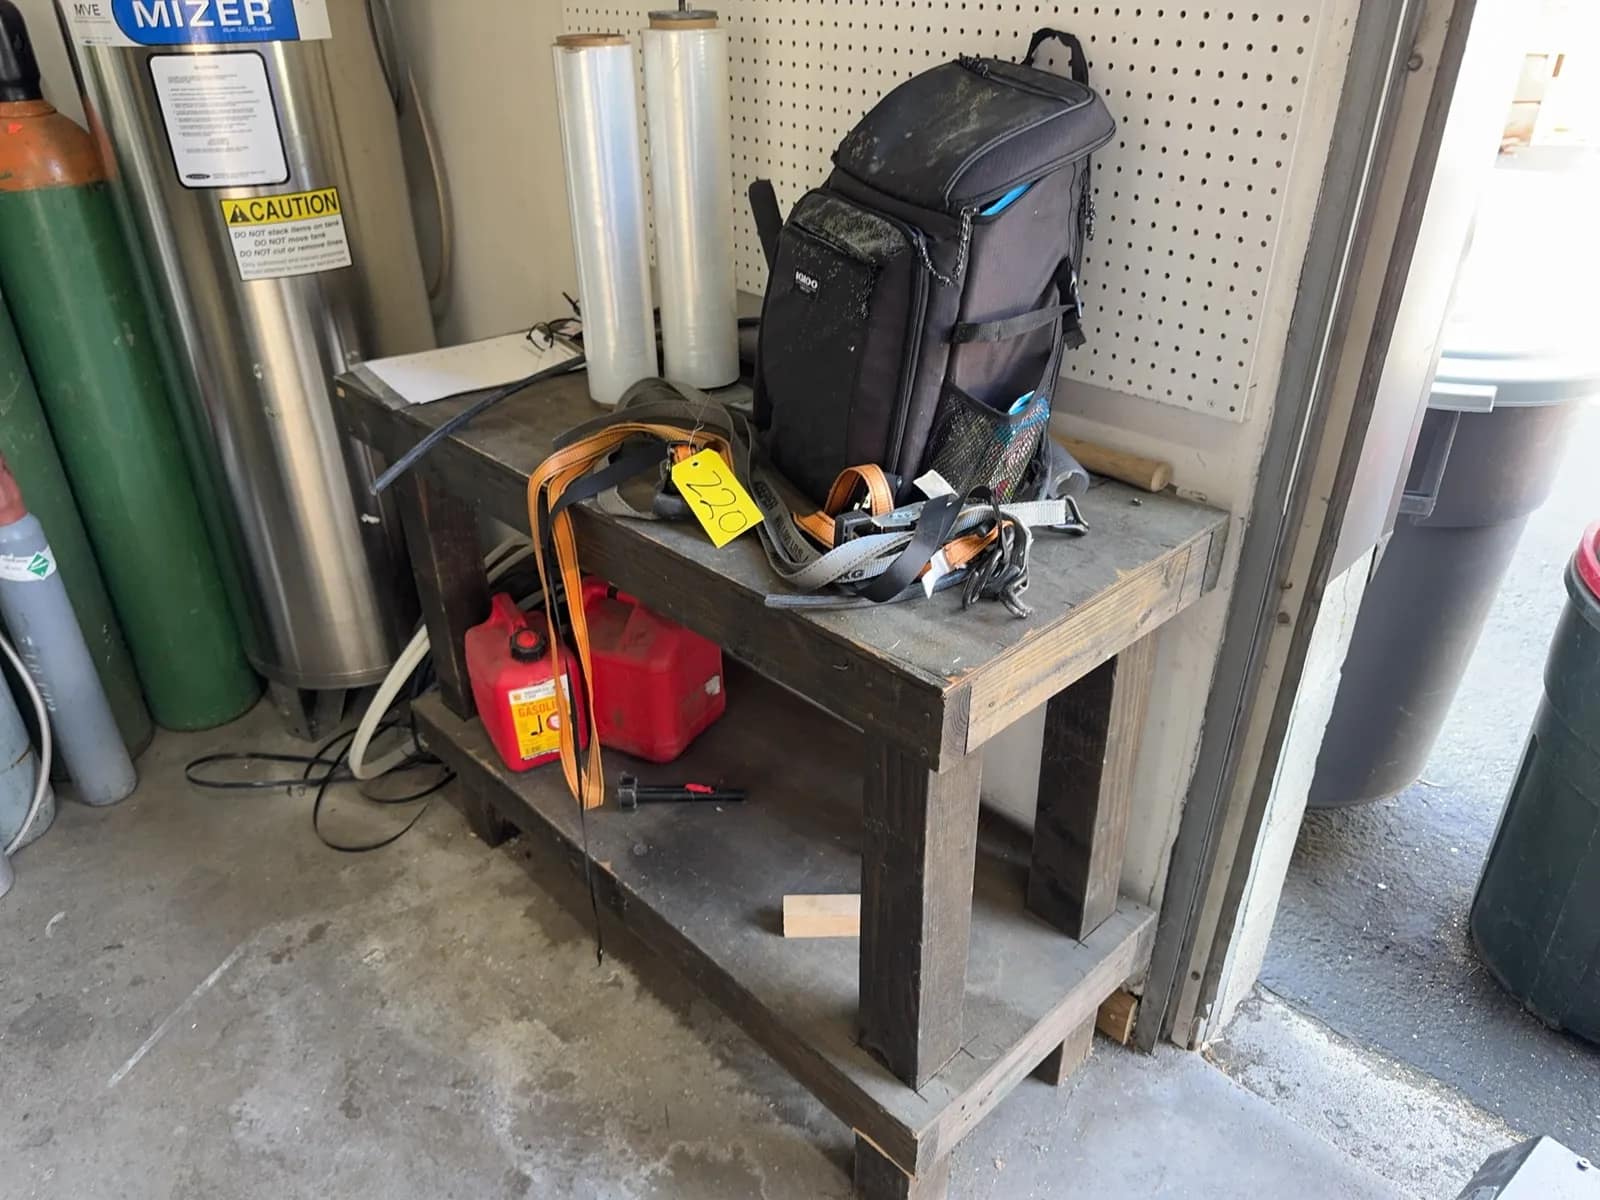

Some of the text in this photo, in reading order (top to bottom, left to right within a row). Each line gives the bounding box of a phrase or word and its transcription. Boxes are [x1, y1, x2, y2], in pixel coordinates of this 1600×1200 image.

[74, 4, 101, 16] MVE
[132, 0, 273, 28] MIZER
[249, 191, 338, 221] CAUTION
[234, 231, 247, 239] DO
[249, 229, 266, 238] NOT
[254, 239, 267, 247] DO
[269, 237, 286, 246] NOT
[288, 235, 309, 243] move
[240, 250, 252, 258] DO
[254, 248, 271, 257] NOT
[298, 243, 325, 252] remove
[686, 470, 748, 533] 220
[518, 702, 557, 717] GASOLI
